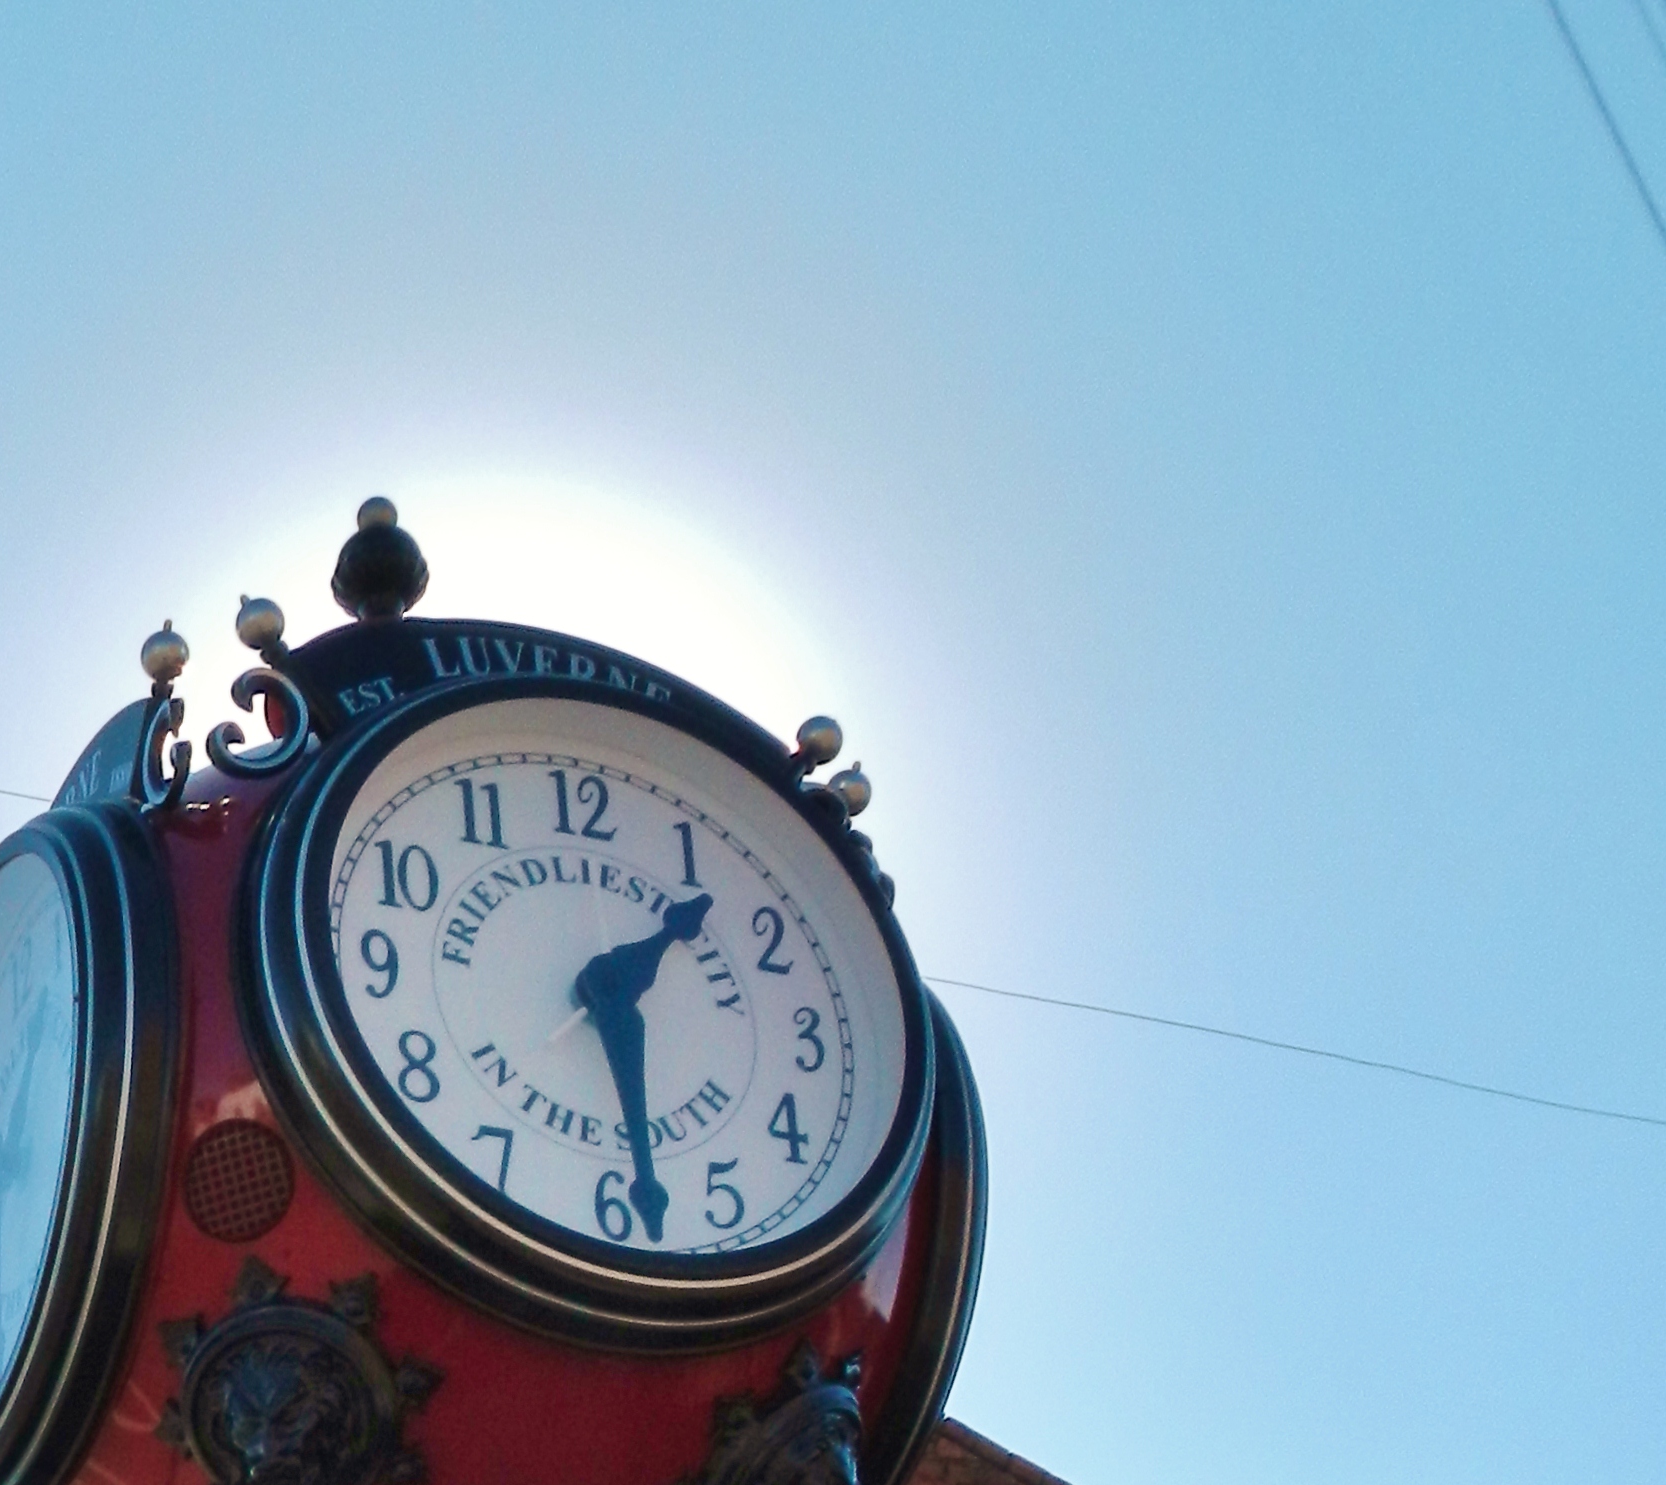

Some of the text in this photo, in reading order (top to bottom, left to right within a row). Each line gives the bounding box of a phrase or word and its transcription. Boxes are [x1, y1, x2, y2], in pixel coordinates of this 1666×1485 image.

[338, 676, 406, 718] EST.
[455, 777, 510, 850] 11
[547, 769, 618, 842] 12
[374, 840, 440, 912] 10
[673, 821, 705, 889] 1
[359, 927, 401, 999] 9
[440, 854, 746, 1017] FRIENDLIEST ITY
[750, 905, 795, 977] 2
[396, 1029, 442, 1104] 8
[792, 1006, 827, 1074] 3
[470, 1042, 518, 1088] IN
[520, 1083, 603, 1147] THE
[767, 1092, 810, 1167] 4
[470, 1125, 515, 1192] 7
[704, 1158, 747, 1230] 5
[593, 1170, 634, 1242] 6
